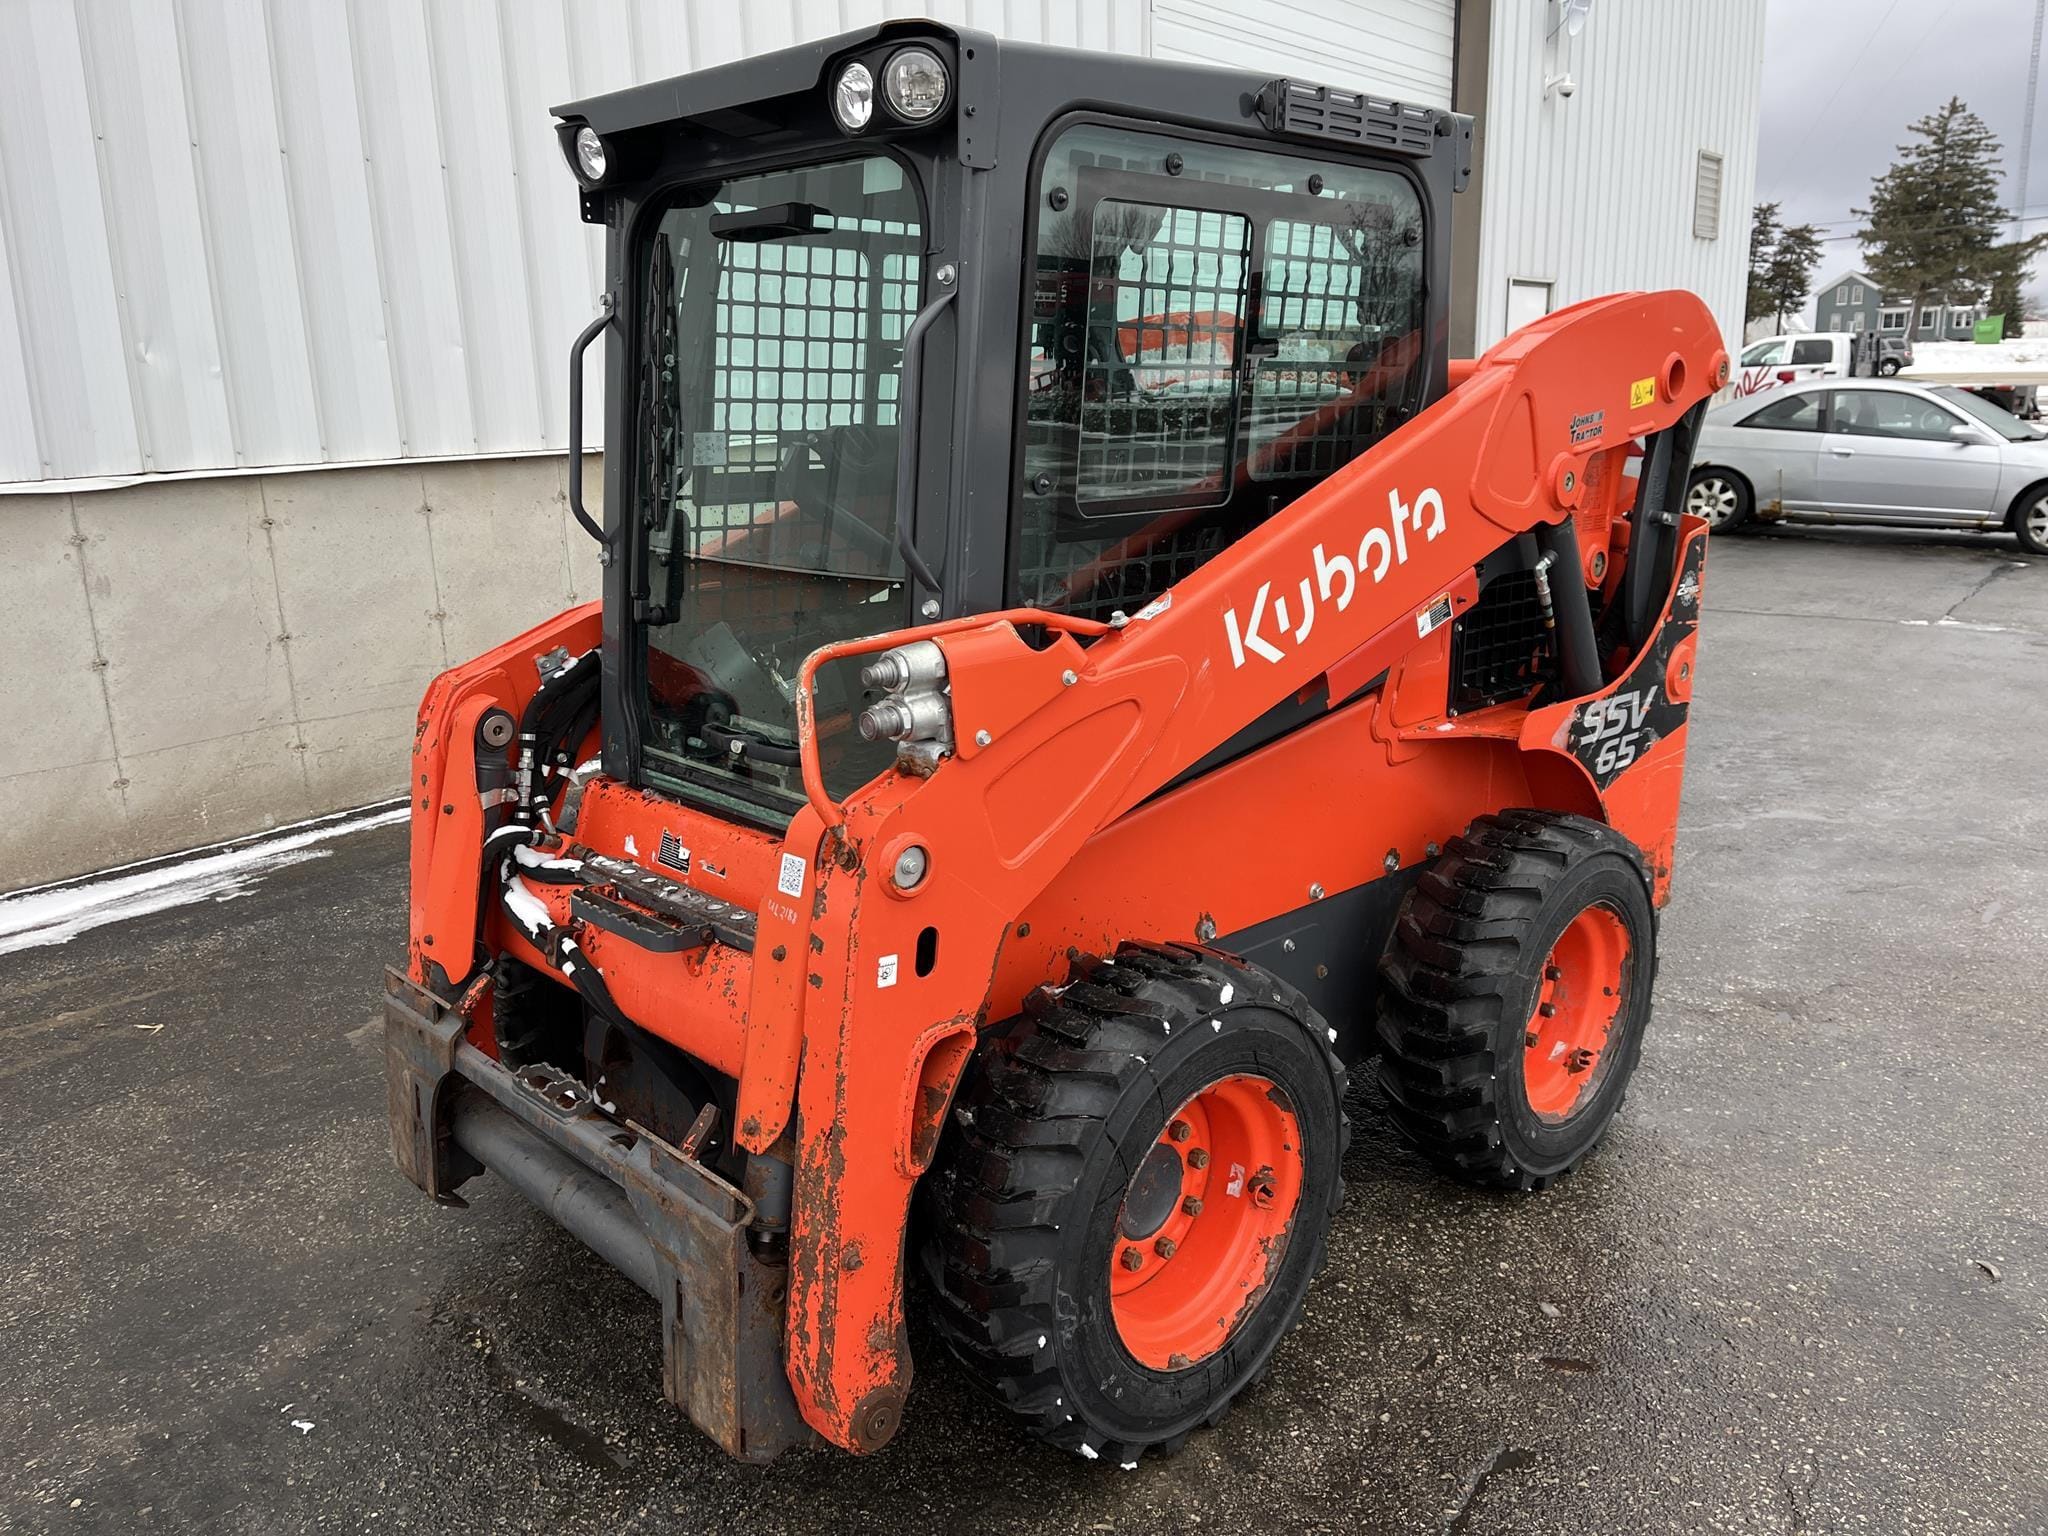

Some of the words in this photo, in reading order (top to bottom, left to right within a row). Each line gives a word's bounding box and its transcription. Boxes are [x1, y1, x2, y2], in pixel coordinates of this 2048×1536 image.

[1570, 410, 1604, 430] JOHNSN
[1223, 487, 1446, 669] Kubota
[1580, 685, 1658, 746] SSV
[1596, 731, 1640, 775] 65
